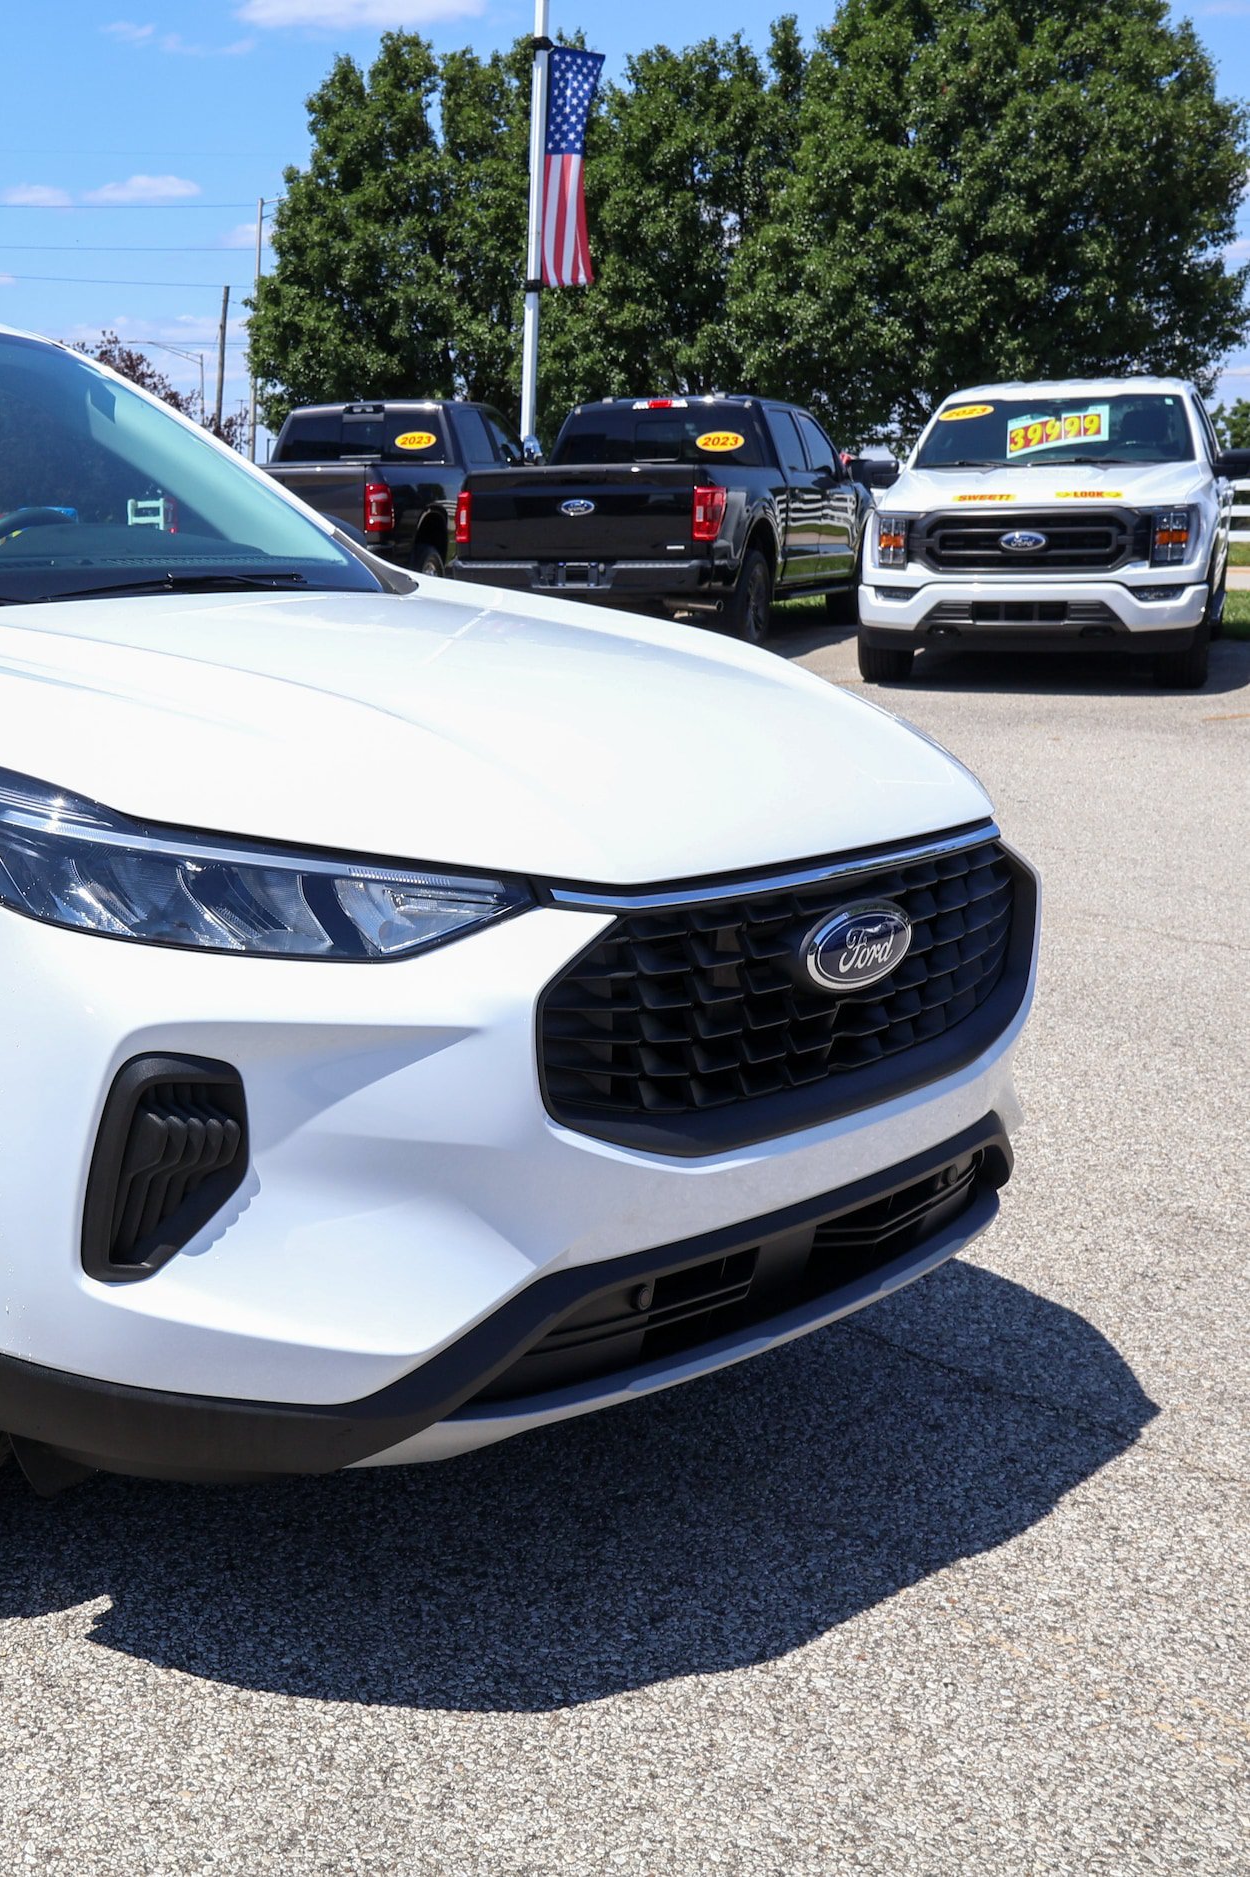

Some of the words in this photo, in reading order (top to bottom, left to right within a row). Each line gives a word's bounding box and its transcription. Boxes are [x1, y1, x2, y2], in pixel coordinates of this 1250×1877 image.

[399, 435, 432, 446] 2023
[701, 436, 739, 447] 2023
[1010, 414, 1101, 452] 39999
[839, 924, 894, 974] Ford
